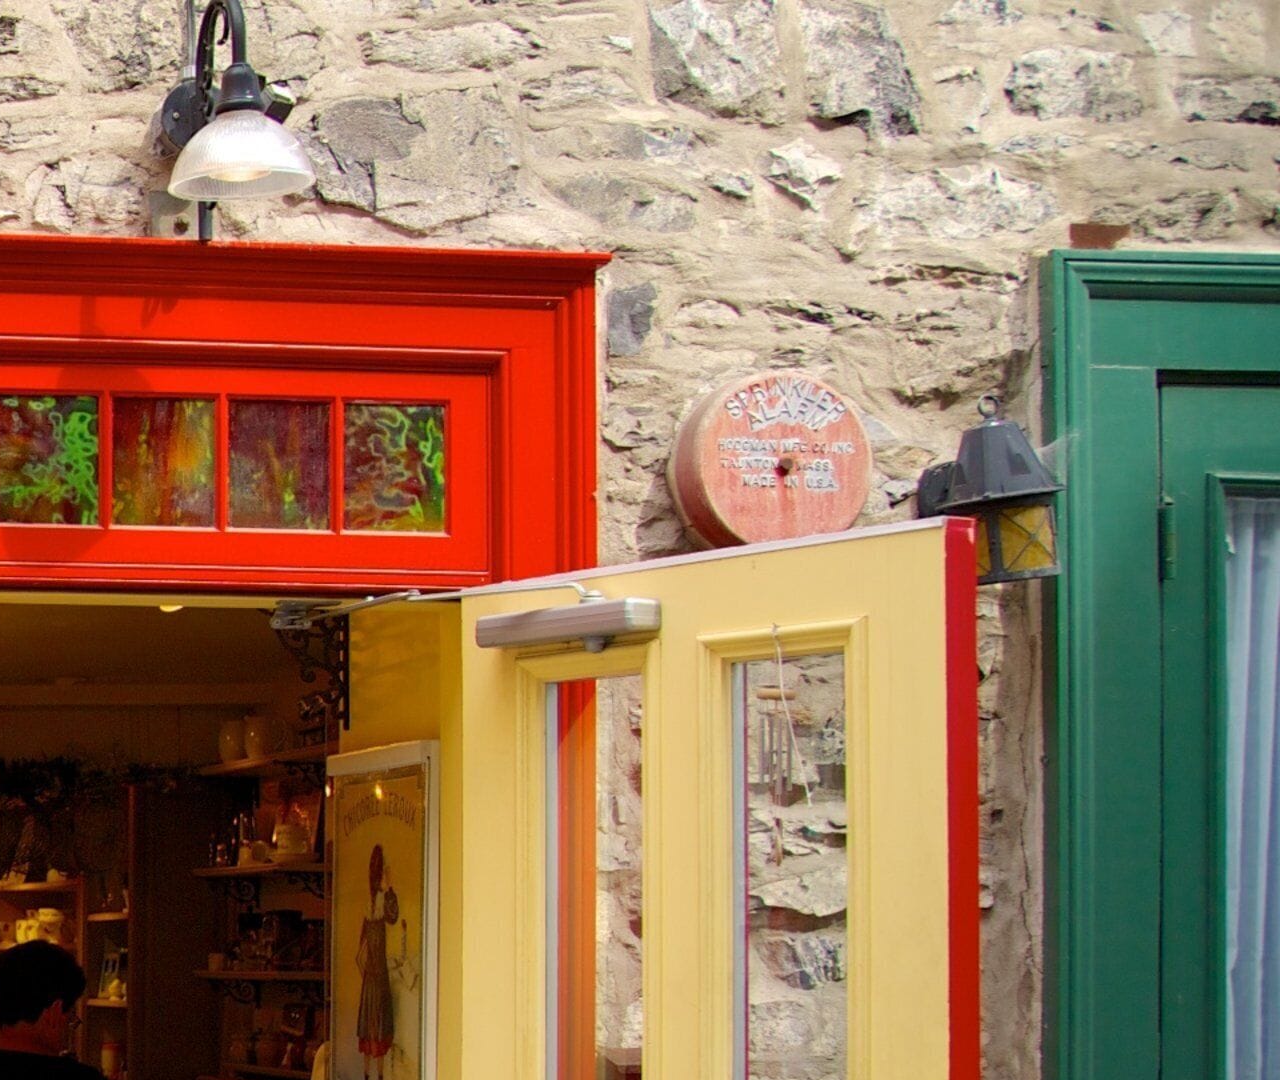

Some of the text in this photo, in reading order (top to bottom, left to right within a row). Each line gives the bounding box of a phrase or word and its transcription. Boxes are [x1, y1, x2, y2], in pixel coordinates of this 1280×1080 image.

[725, 377, 849, 420] SPRINKLER
[746, 400, 825, 431] ALARM
[742, 476, 776, 489] MADE
[784, 477, 798, 489] IN
